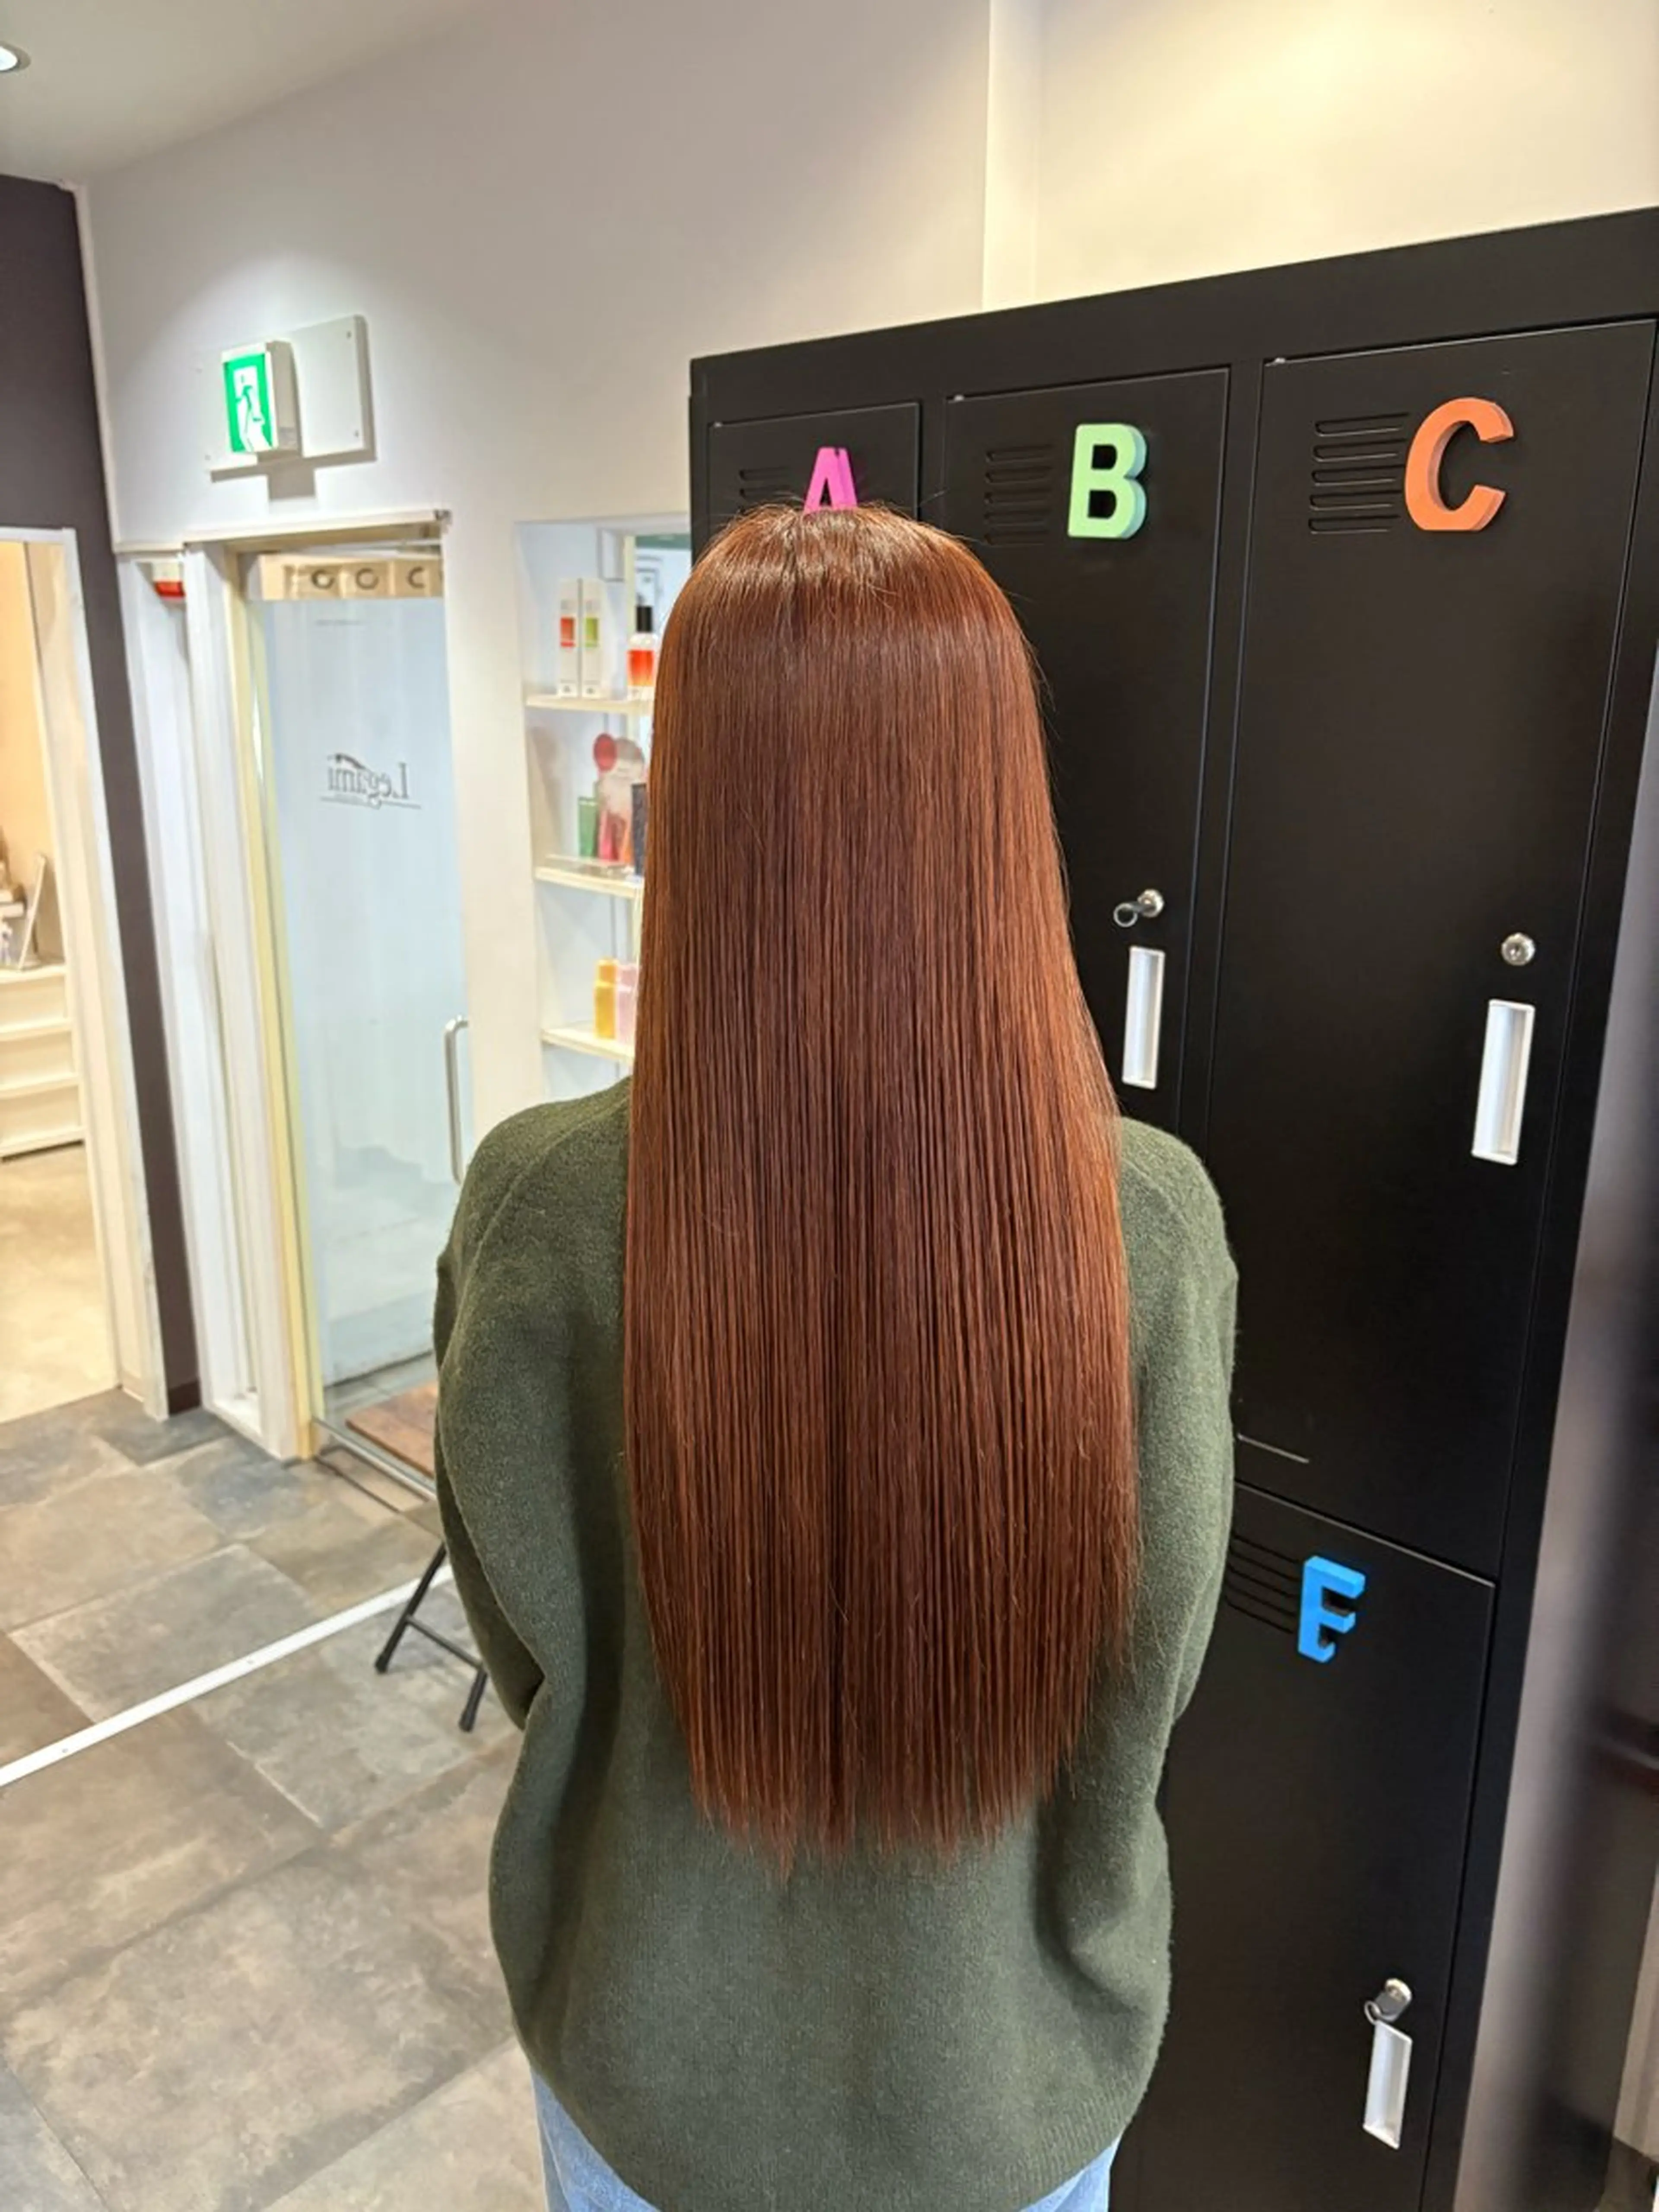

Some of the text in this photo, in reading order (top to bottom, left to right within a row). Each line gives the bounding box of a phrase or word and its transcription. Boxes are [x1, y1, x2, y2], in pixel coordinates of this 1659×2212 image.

[803, 447, 858, 514] A
[1068, 423, 1147, 538] B
[1404, 397, 1514, 531] C
[1298, 1555, 1366, 1663] F
